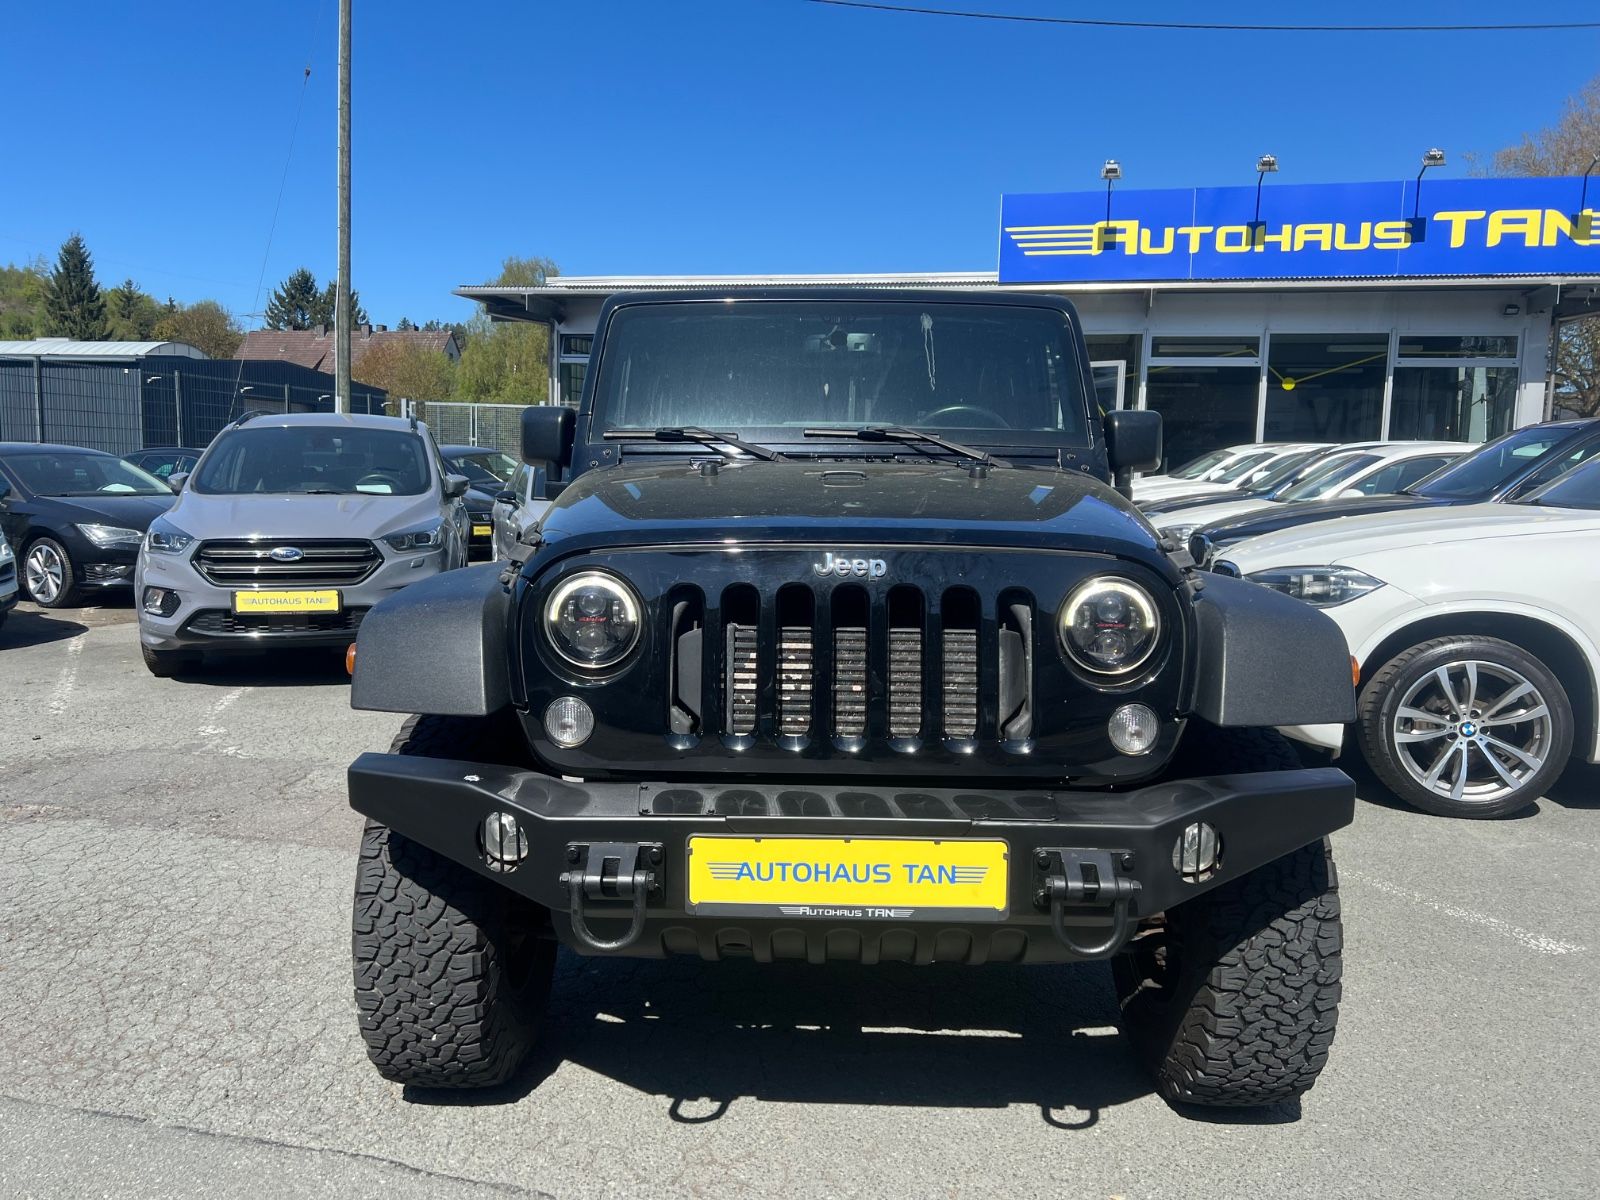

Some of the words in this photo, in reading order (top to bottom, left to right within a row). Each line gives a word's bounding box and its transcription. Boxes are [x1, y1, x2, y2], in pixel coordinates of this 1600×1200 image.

[1091, 219, 1413, 255] AUTOHAUS
[1433, 208, 1593, 249] TAN
[814, 552, 887, 581] Jeep
[251, 597, 302, 605] AUTOHAUS
[736, 862, 891, 884] AUTOHAUS
[903, 864, 957, 885] TAN
[865, 908, 895, 918] TAN
